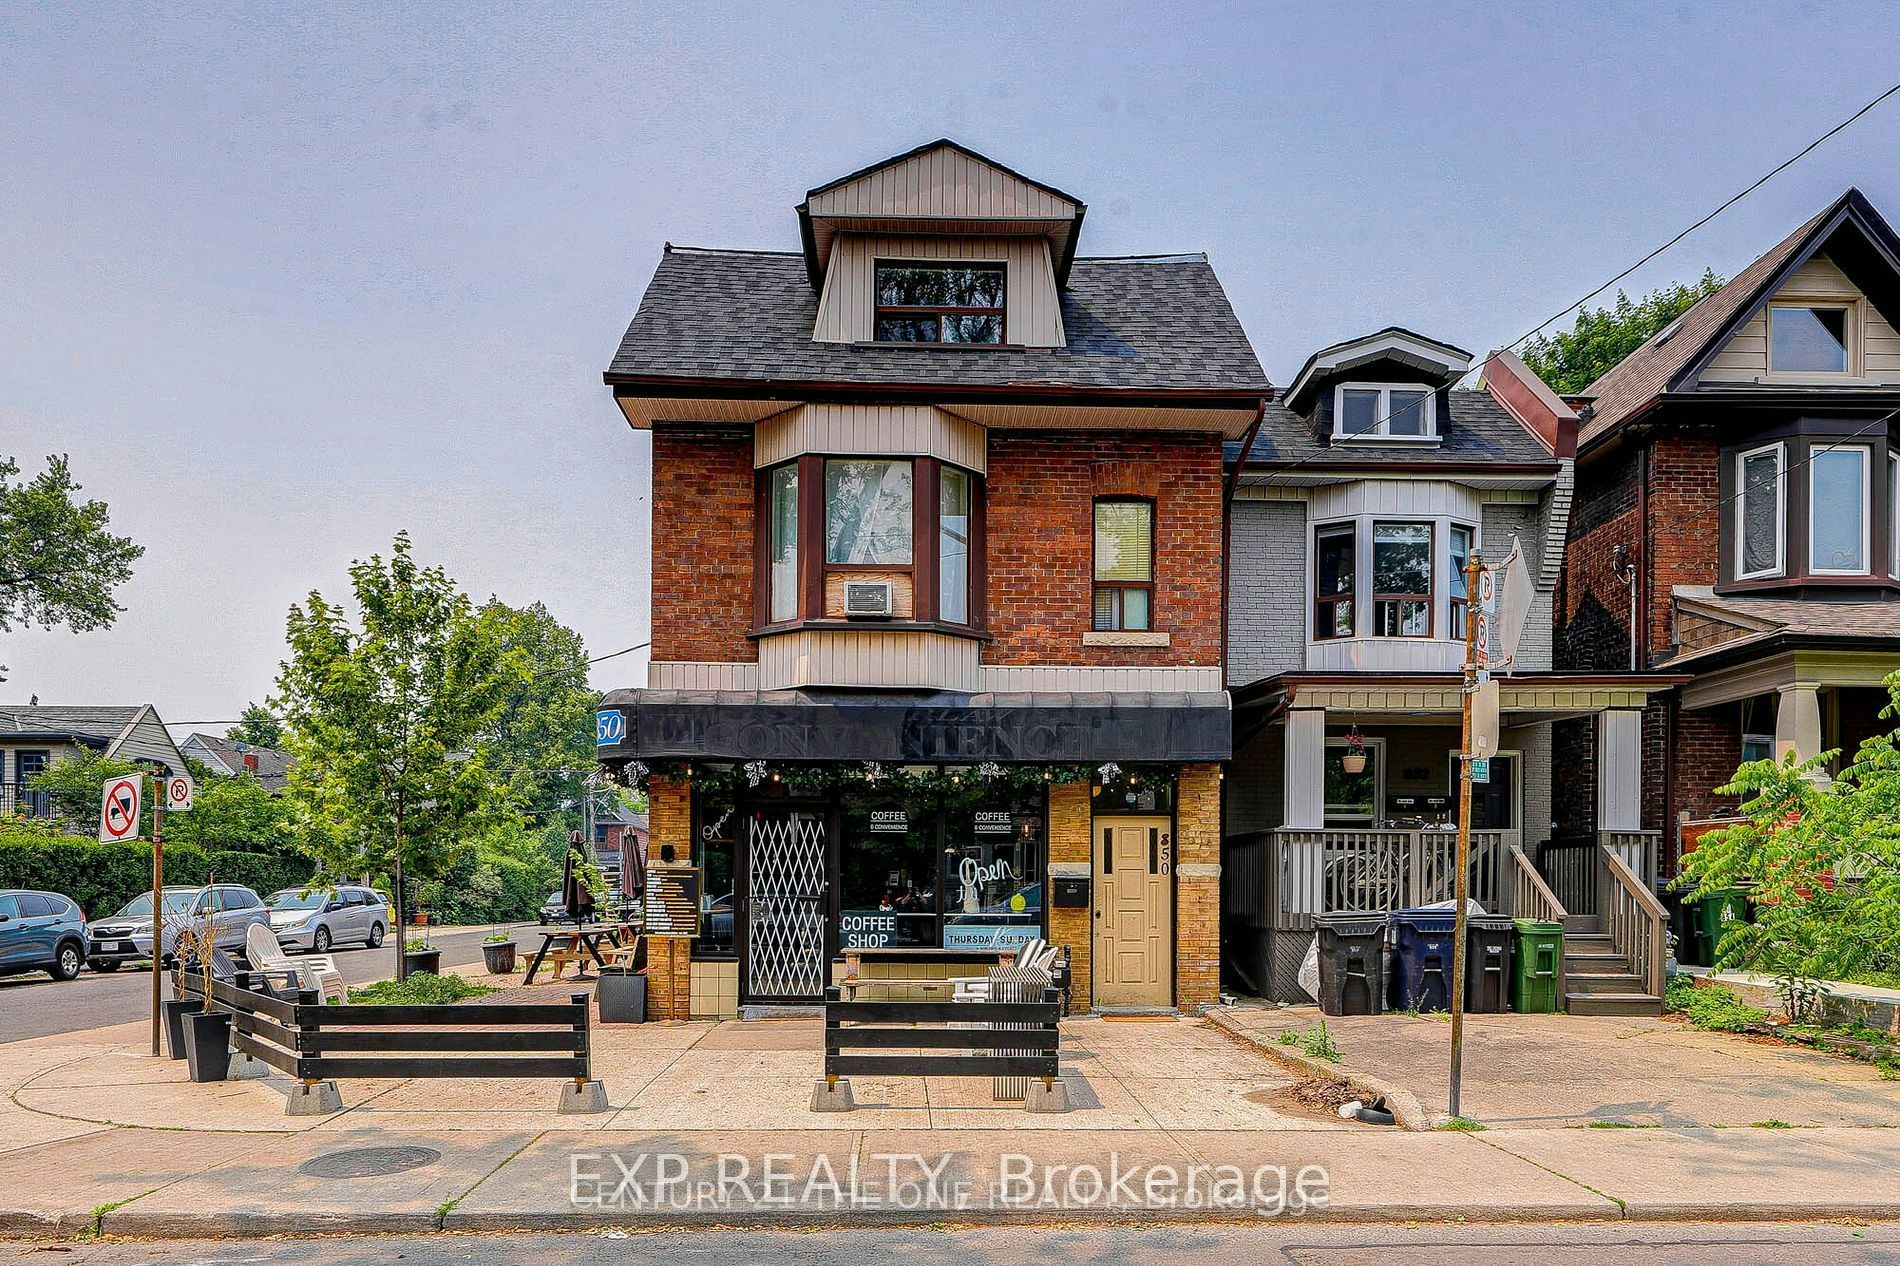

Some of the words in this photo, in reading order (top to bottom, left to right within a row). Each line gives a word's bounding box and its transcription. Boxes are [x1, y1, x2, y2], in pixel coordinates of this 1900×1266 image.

[871, 811, 906, 820] COFFEE
[975, 812, 1010, 821] COFFEE
[959, 857, 1023, 890] Open
[842, 916, 895, 931] COFFEE
[848, 933, 889, 949] SHOP
[1000, 935, 1035, 944] SUDAY
